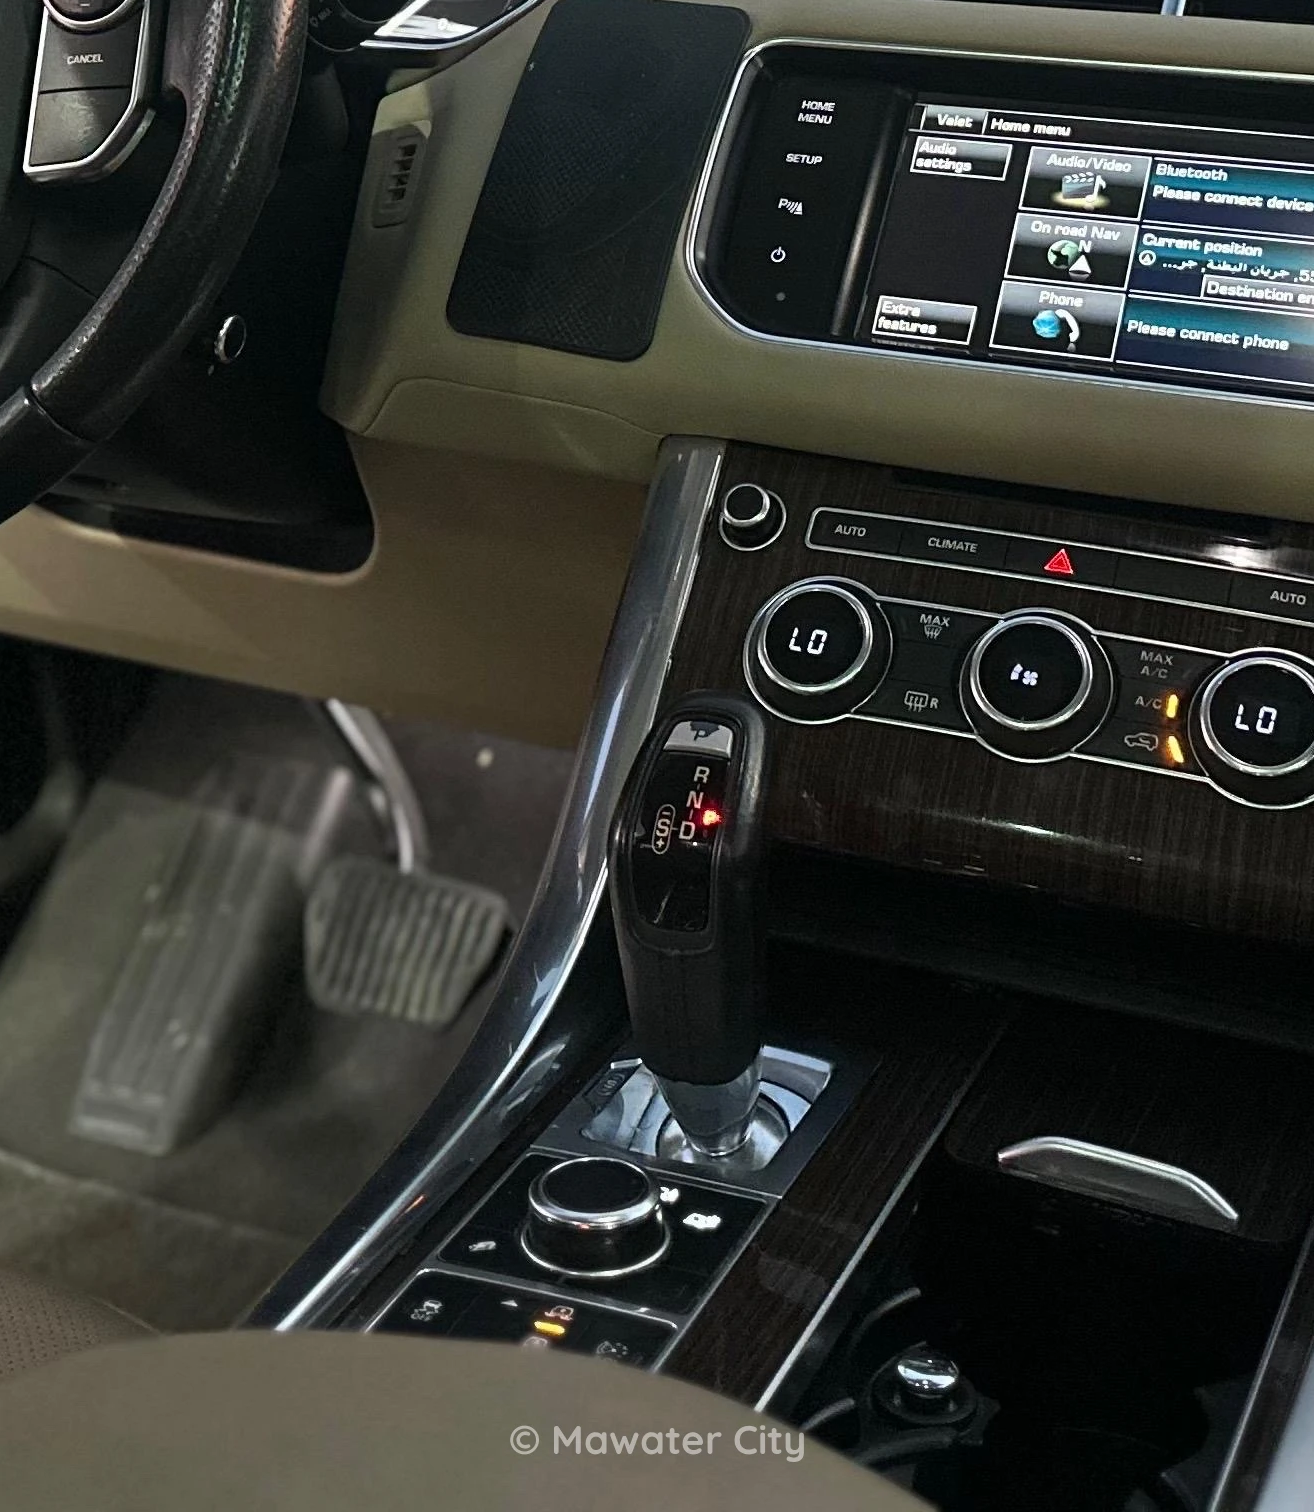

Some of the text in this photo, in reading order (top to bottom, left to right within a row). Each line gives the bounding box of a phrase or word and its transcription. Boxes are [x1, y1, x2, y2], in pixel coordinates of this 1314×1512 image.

[66, 53, 104, 65] CANCEL
[801, 100, 836, 112] HOME
[797, 112, 833, 125] MENU
[936, 114, 973, 129] Valet
[990, 117, 1072, 137] Home menu
[918, 140, 957, 155] Audio
[785, 152, 823, 165] SETUP
[915, 156, 973, 174] settings
[1046, 153, 1132, 173] Audio/Video
[1155, 162, 1229, 182] Bluetooth
[1152, 184, 1201, 202] Please
[1204, 190, 1263, 208] connect
[1030, 220, 1121, 242] On road Nav
[1142, 232, 1264, 259] Current position
[1038, 290, 1084, 308] Phone
[1206, 280, 1294, 304] Destination
[880, 300, 921, 318] Extra
[877, 316, 938, 336] features
[1127, 319, 1290, 351] Please connect phone
[834, 523, 867, 538] AUTO
[927, 536, 979, 554] CLIMATE
[1269, 589, 1307, 606] AUTO
[919, 612, 951, 628] MAX
[1139, 649, 1174, 667] MAX
[1140, 665, 1169, 680] A/C
[1135, 694, 1162, 710] A/C
[693, 766, 711, 785] R
[686, 790, 704, 809] N
[655, 817, 671, 837] S
[678, 820, 696, 841] D
